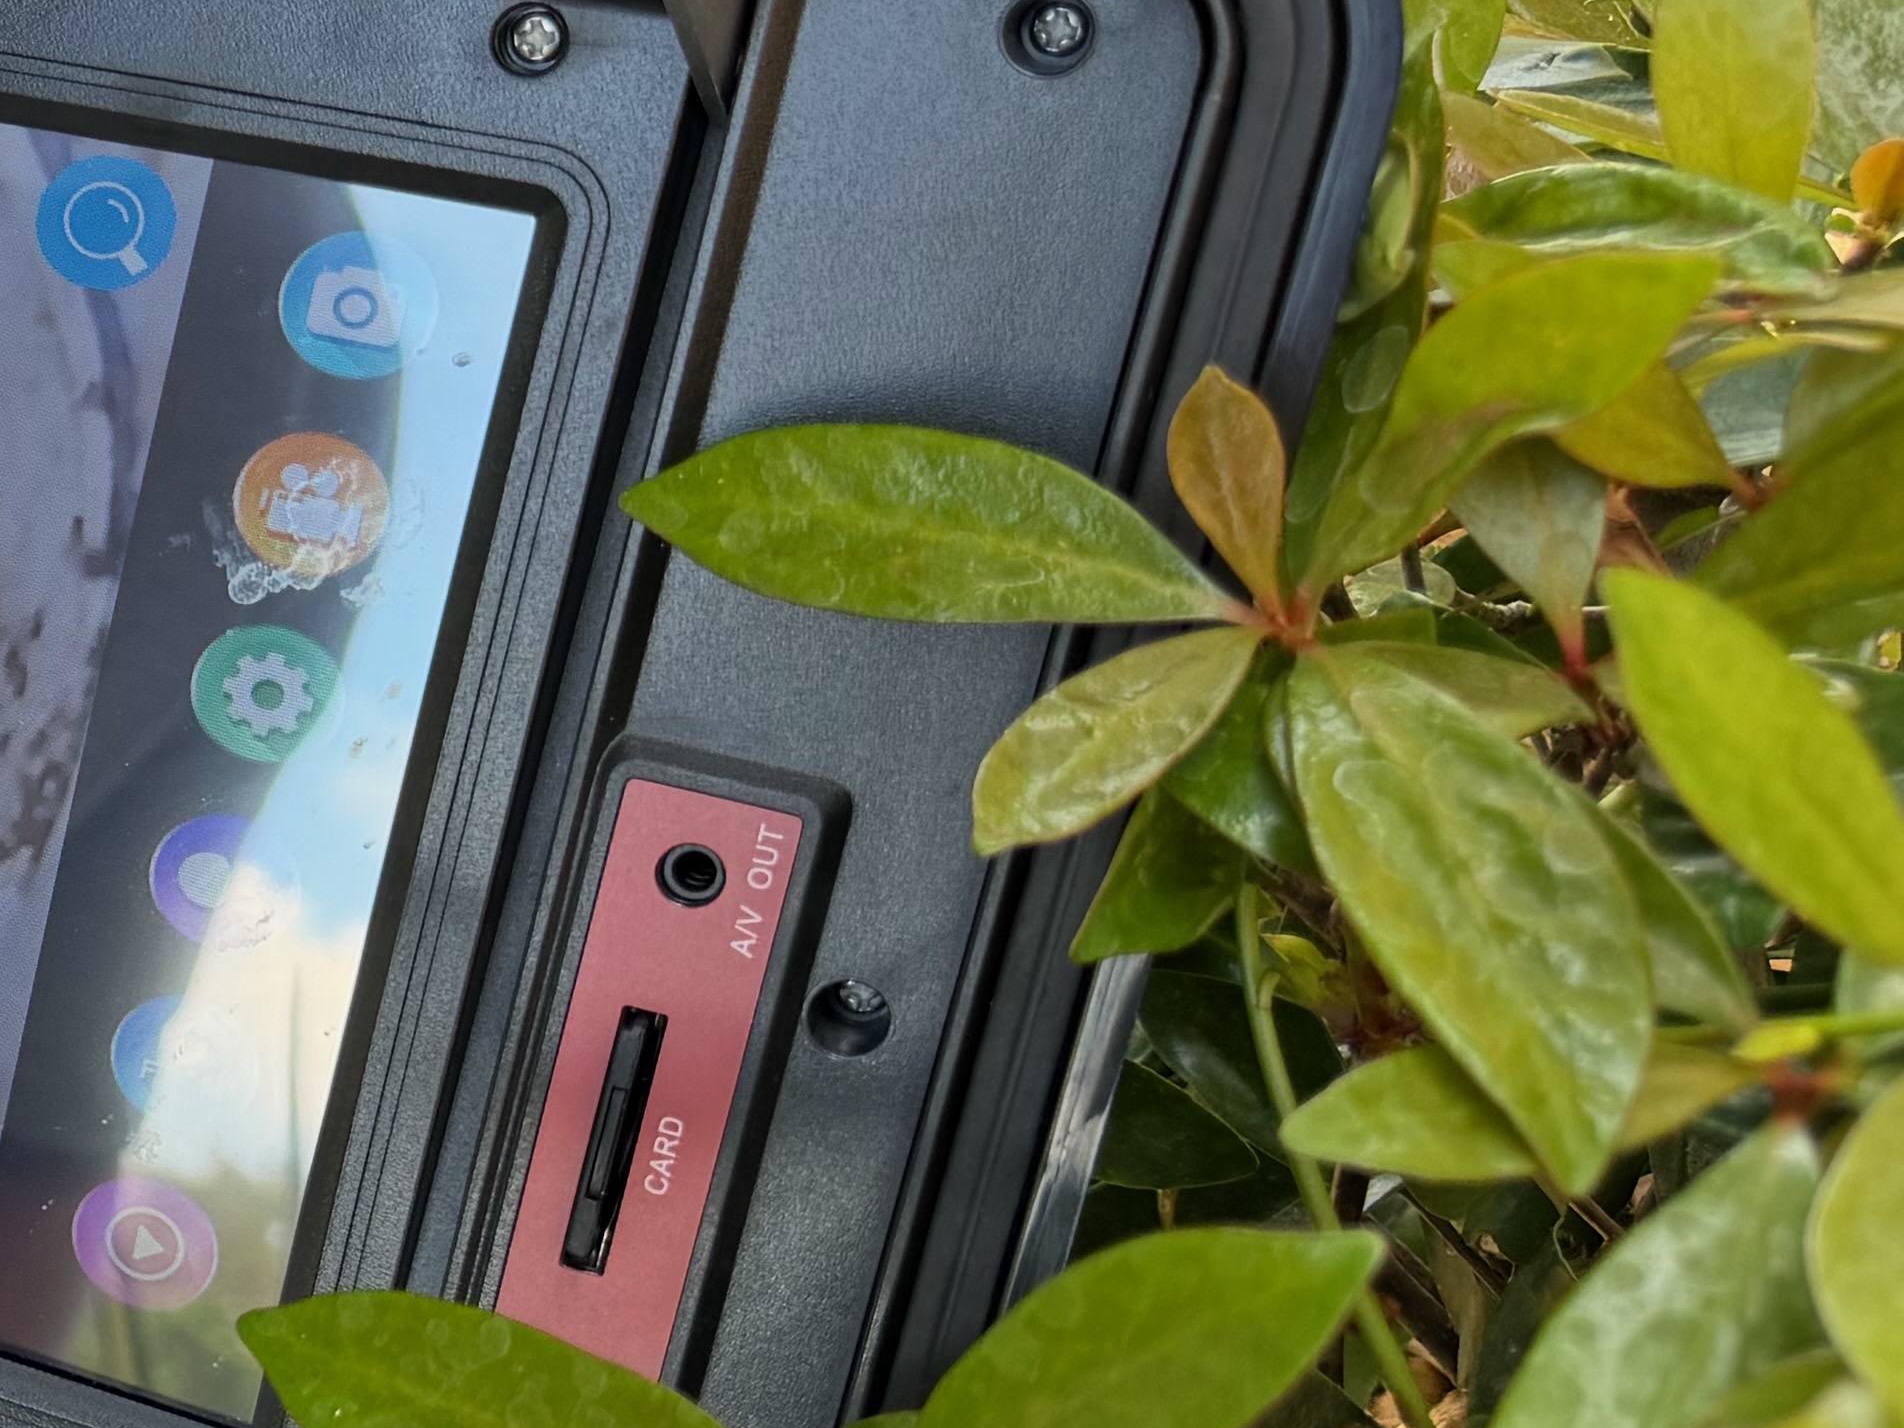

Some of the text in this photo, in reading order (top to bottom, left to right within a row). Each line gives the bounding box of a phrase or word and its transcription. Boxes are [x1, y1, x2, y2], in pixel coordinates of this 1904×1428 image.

[728, 823, 784, 960] A/V OUT
[643, 1116, 685, 1196] CARD
